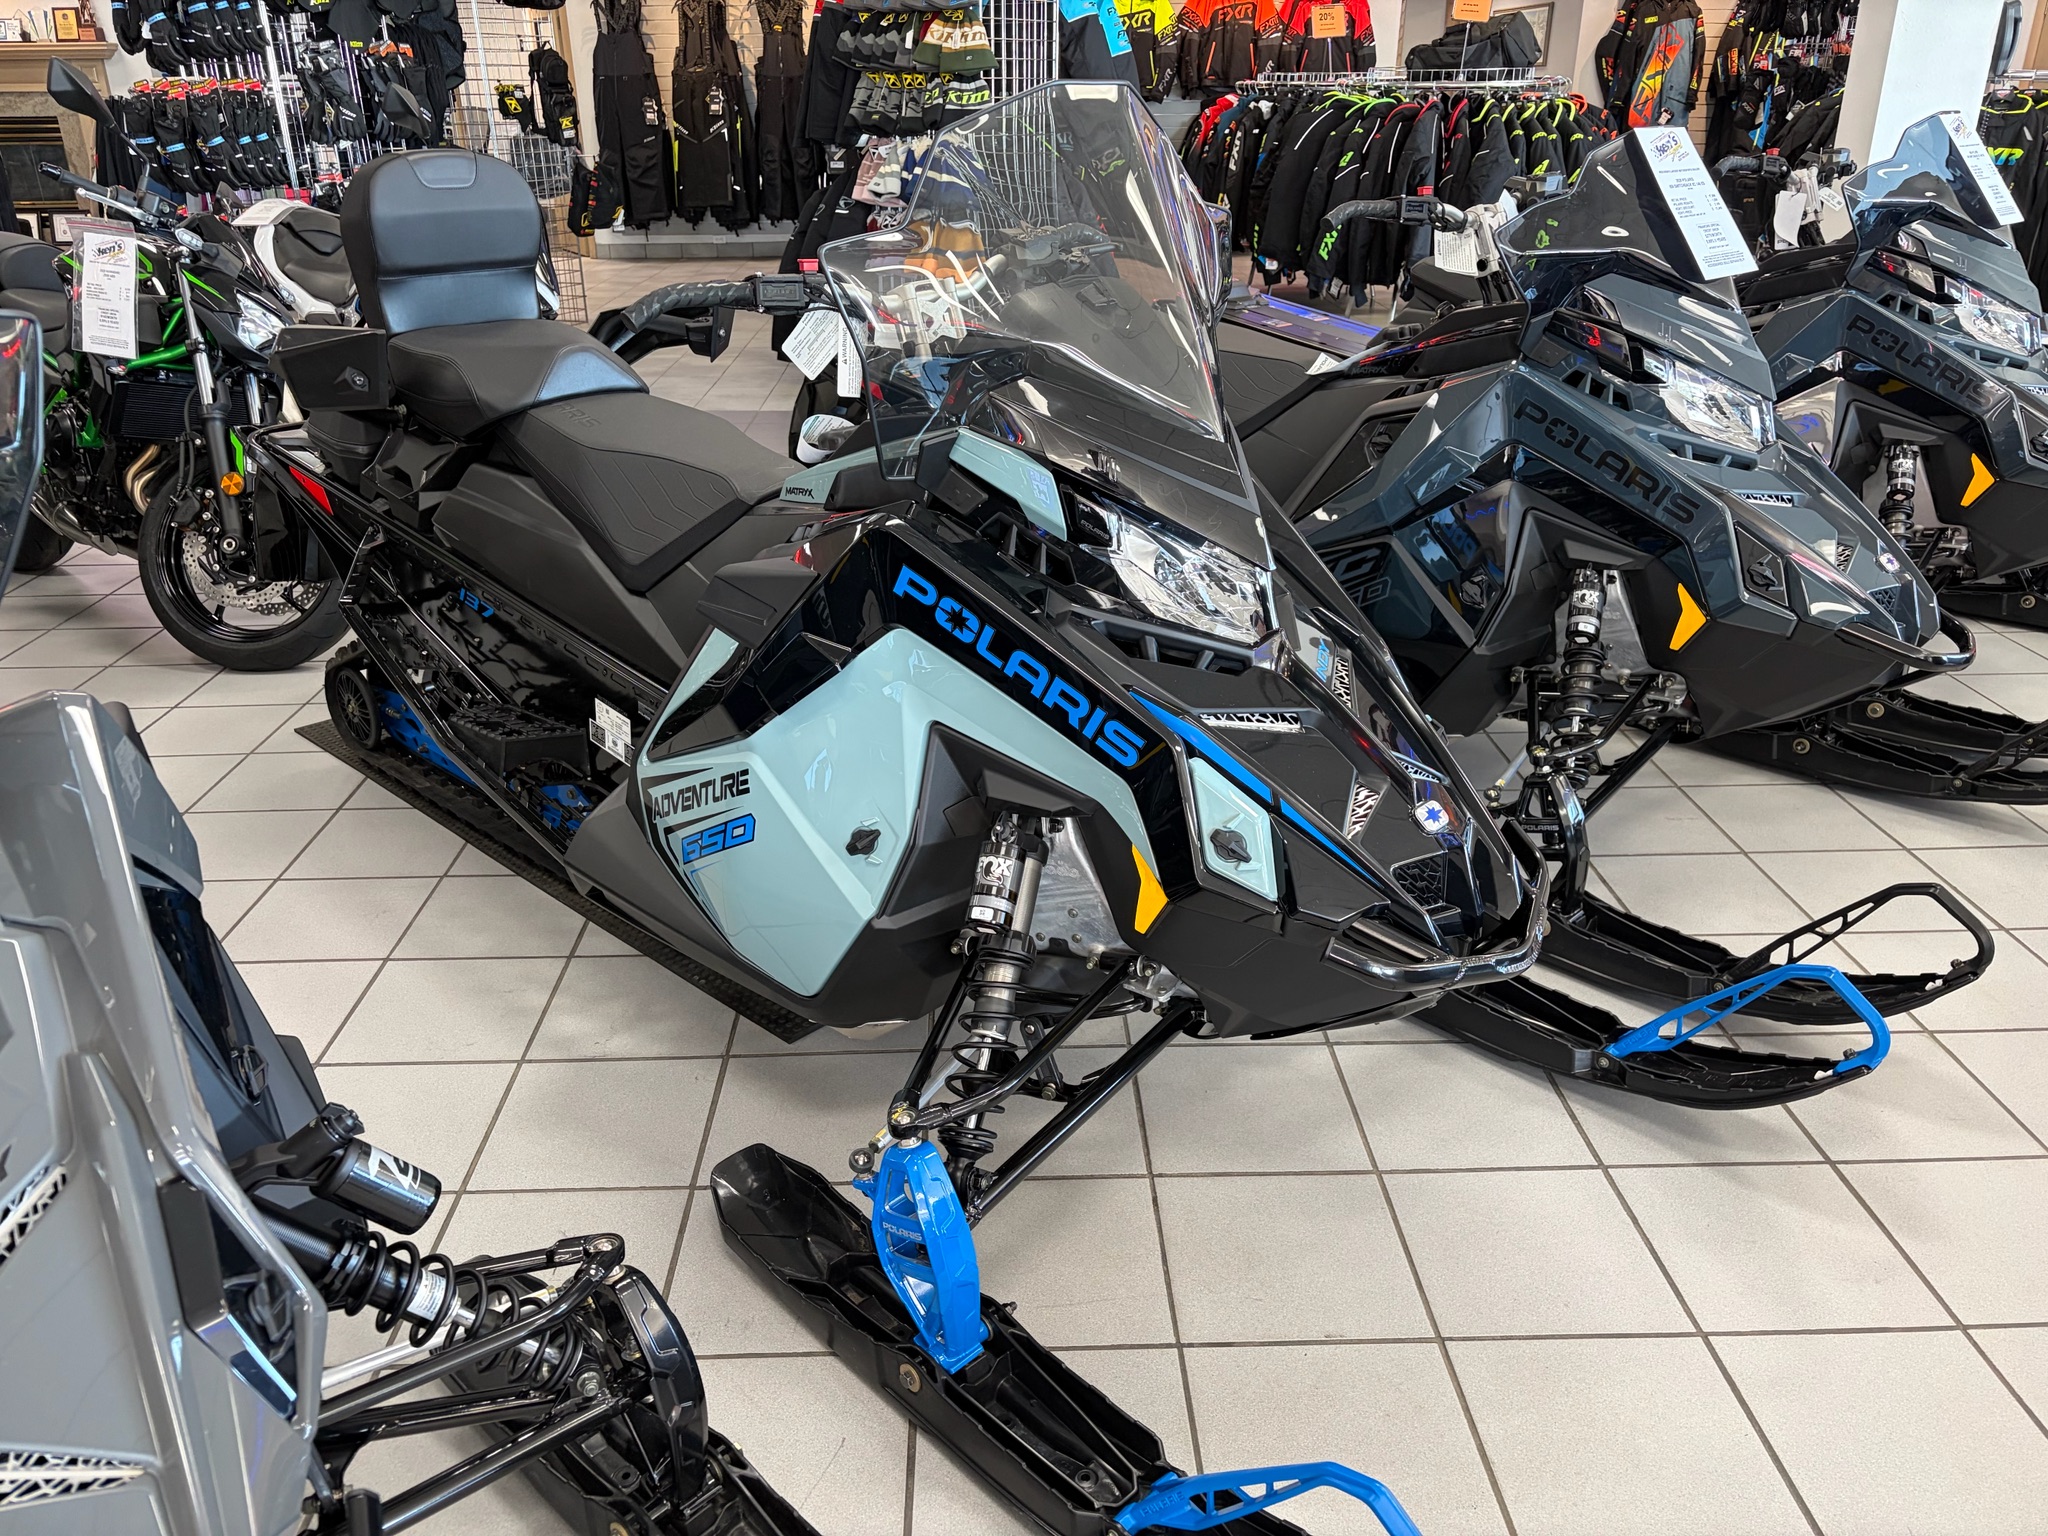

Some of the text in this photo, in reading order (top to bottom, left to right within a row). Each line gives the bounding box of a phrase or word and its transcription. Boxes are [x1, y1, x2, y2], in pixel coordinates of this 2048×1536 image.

[1218, 4, 1254, 25] FXR
[1319, 12, 1335, 21] 20%
[1229, 131, 1242, 171] FXR
[1987, 147, 2024, 166] XR
[841, 326, 849, 359] WARNING
[1846, 314, 1994, 411] POLARIS
[1513, 398, 1701, 524] POLARIS
[785, 487, 815, 499] MATRYX
[1080, 519, 1110, 540] POLARIS
[460, 587, 495, 618] 137
[893, 563, 1147, 768] POLARIS
[652, 768, 750, 822] ADVENTURE
[681, 813, 756, 865] 650
[883, 1221, 922, 1241] POLARIS
